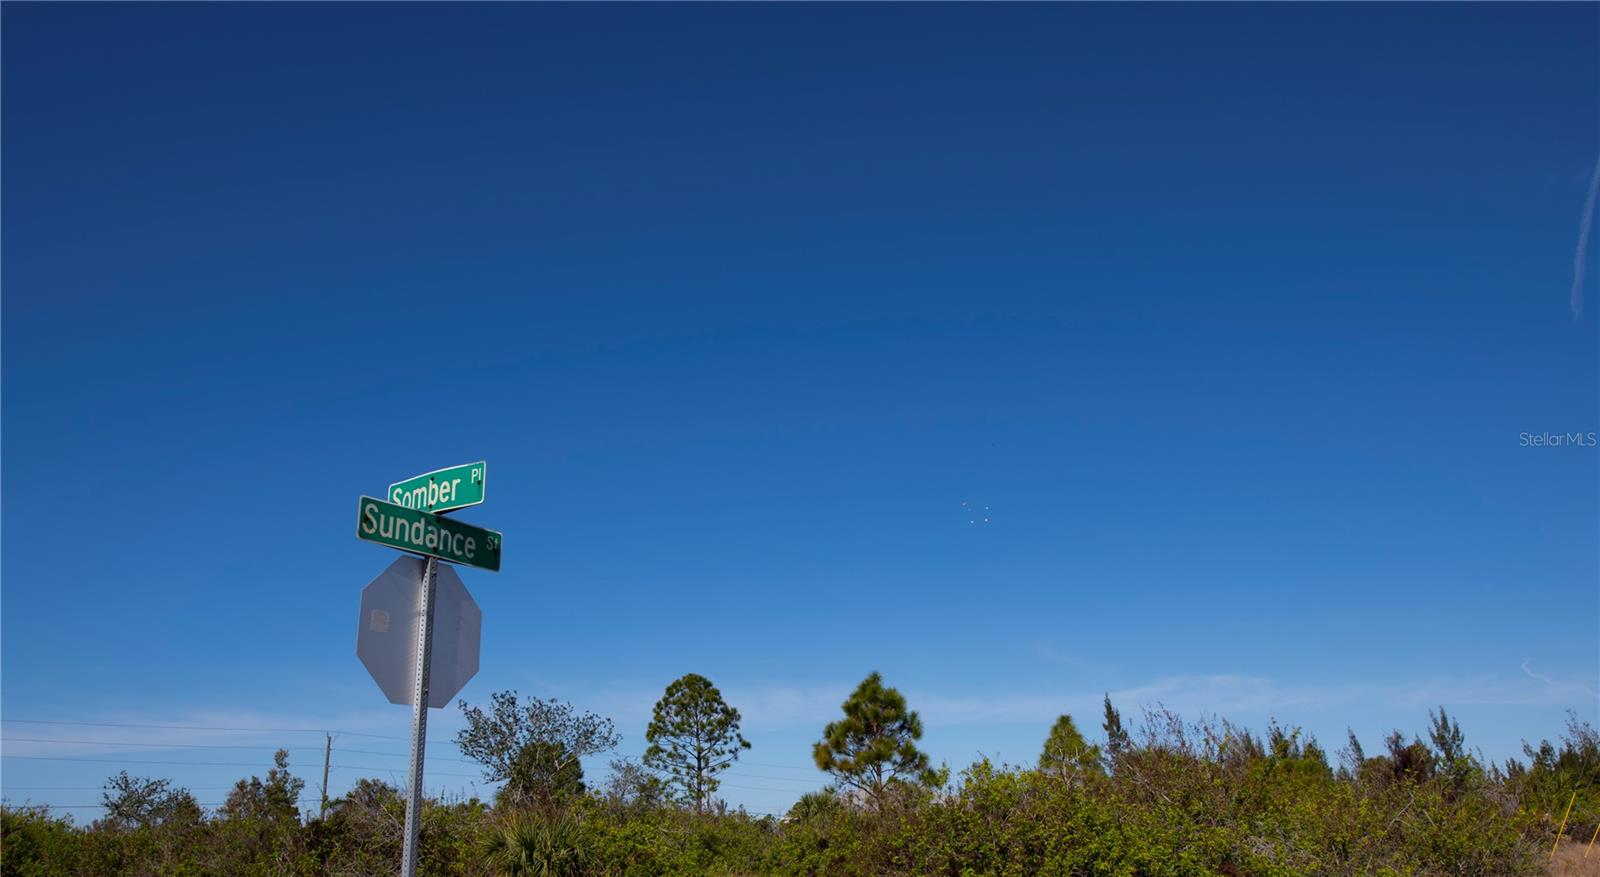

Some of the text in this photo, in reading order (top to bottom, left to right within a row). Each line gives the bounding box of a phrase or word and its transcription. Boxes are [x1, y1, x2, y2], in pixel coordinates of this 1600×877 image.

[392, 467, 482, 509] Somber Pl
[362, 503, 499, 559] Sundance St
